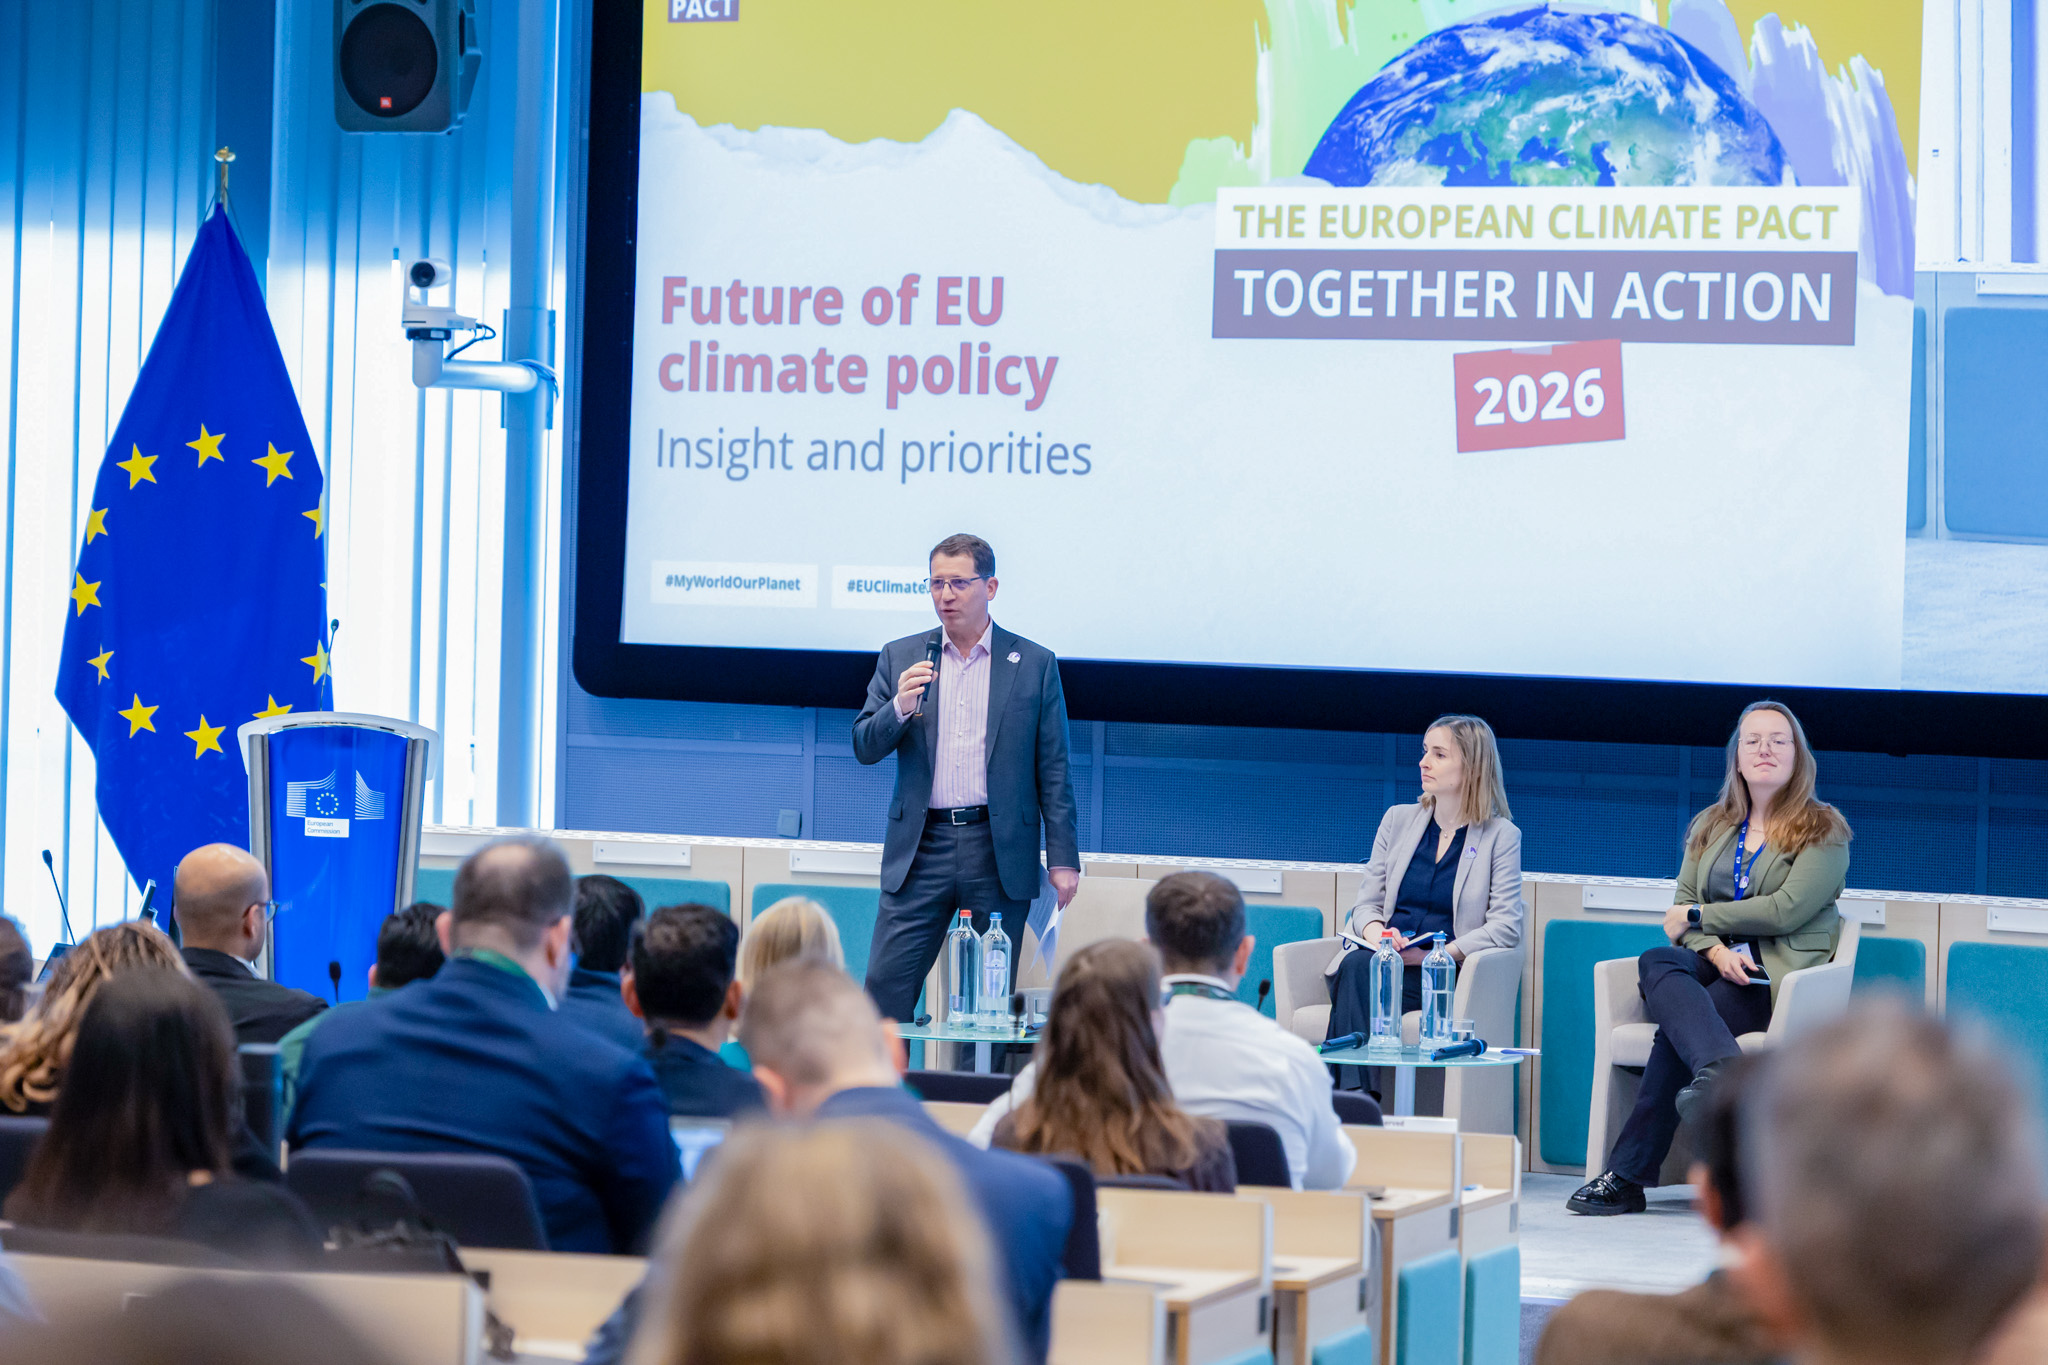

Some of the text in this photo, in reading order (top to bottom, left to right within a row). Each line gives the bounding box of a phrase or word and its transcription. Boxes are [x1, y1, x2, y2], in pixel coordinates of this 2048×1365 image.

[672, 0, 732, 18] PACT
[1233, 204, 1838, 240] THE EUROPEAN CLIMATE PACT
[662, 273, 1004, 327] Future of EU
[1234, 269, 1831, 321] TOGETHER IN ACTION
[658, 340, 1059, 412] climate policy
[1473, 368, 1605, 426] 2026
[657, 426, 1092, 485] Insight and priorities
[665, 575, 801, 591] #MyWorldOurPlanet
[847, 579, 929, 594] #EUClimate
